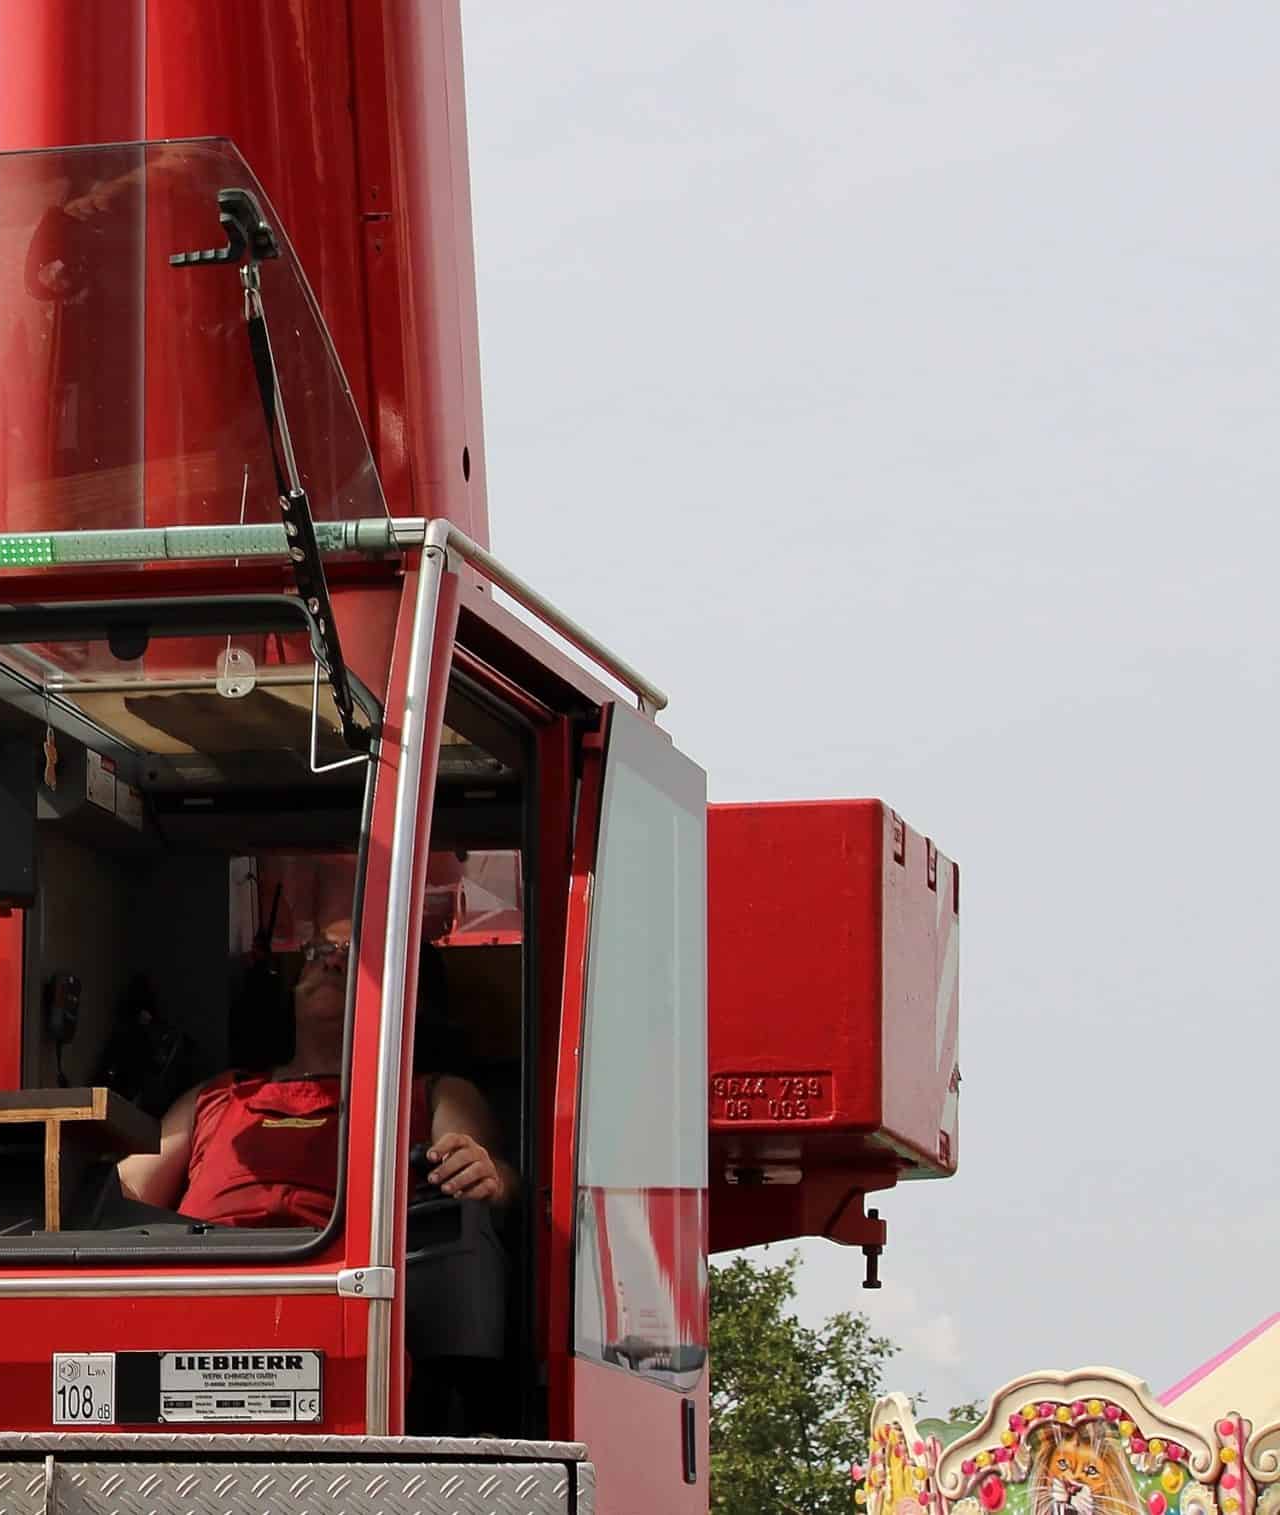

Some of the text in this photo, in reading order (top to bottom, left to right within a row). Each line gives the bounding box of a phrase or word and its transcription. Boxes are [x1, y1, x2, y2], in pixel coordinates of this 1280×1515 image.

[175, 1355, 304, 1370] LIEBHERR
[58, 1385, 111, 1419] 108 dB
